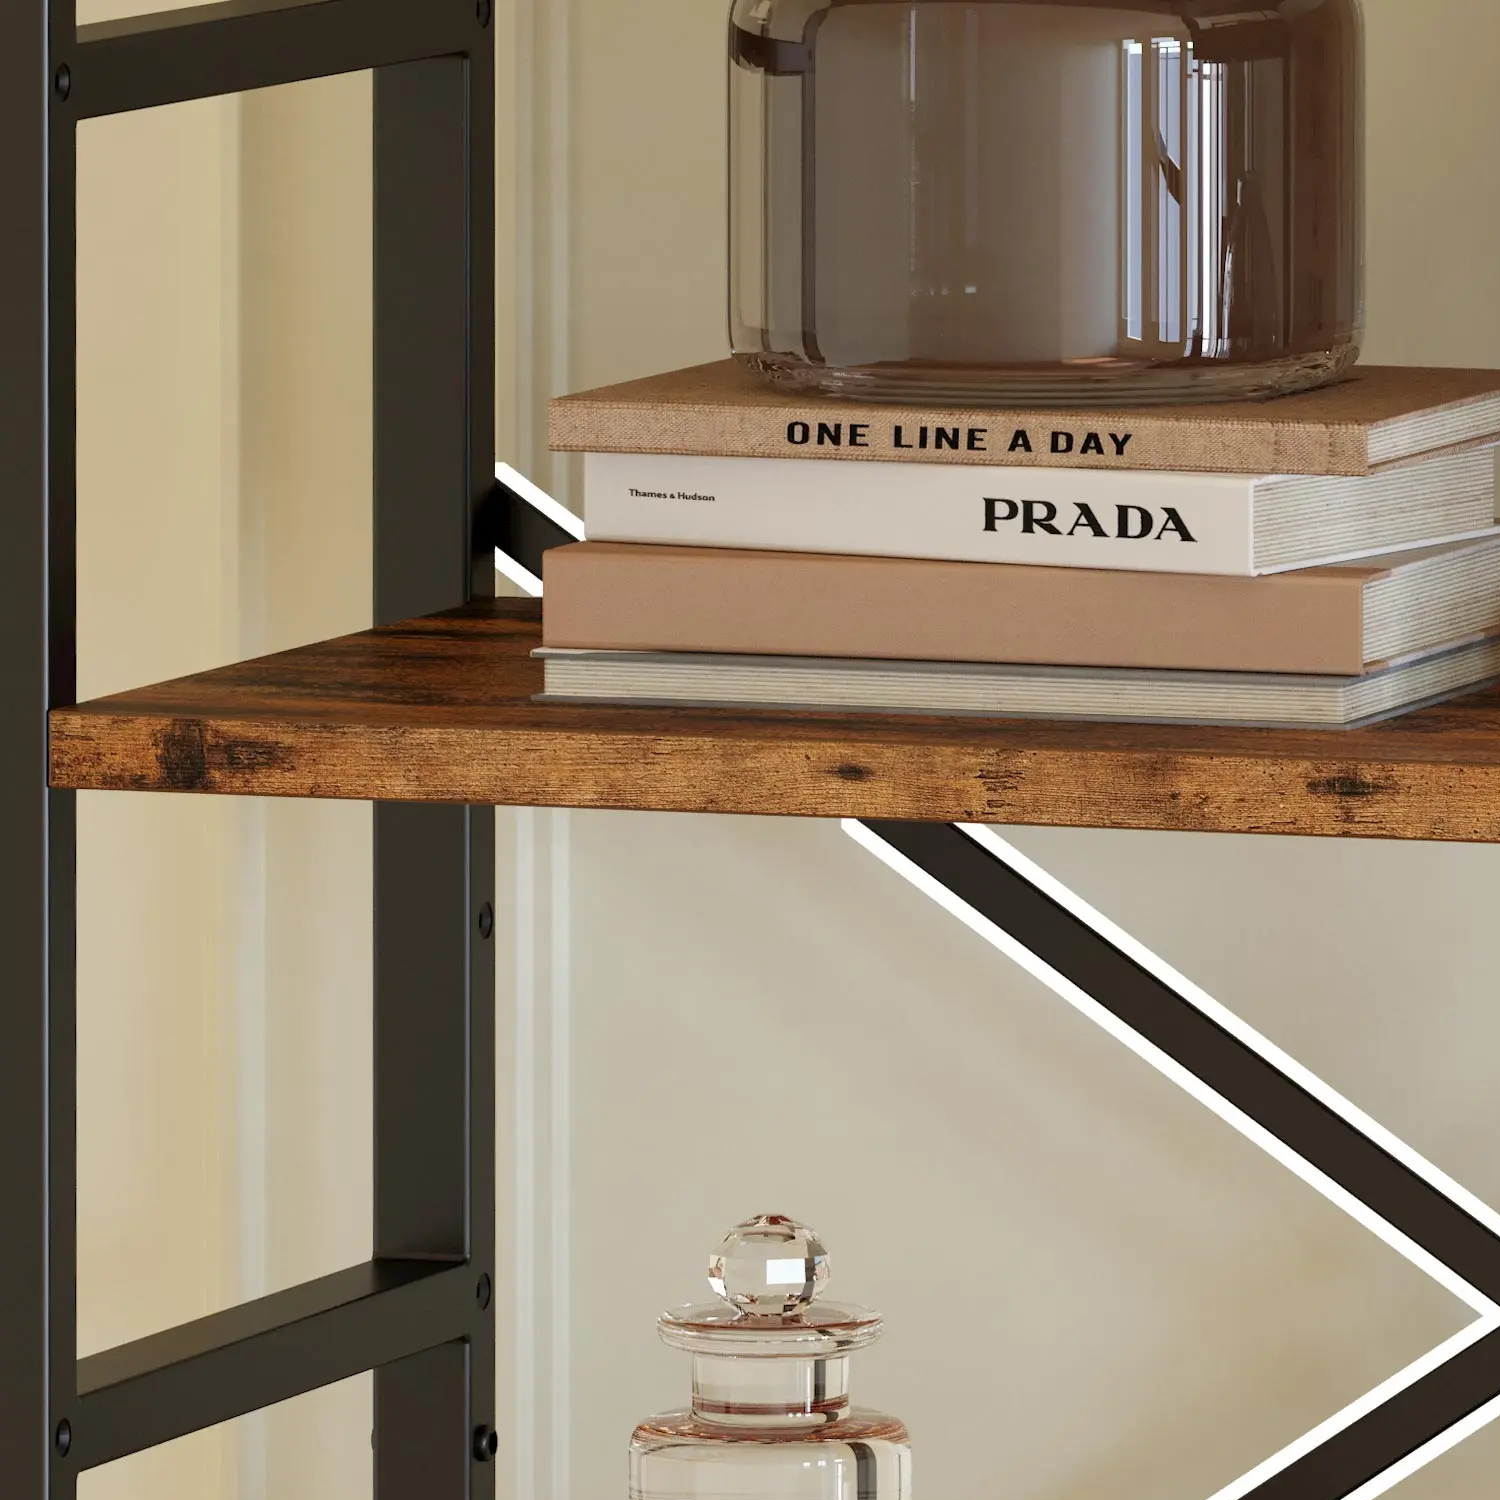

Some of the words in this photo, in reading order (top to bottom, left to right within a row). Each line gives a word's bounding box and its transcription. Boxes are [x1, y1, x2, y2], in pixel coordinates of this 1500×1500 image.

[787, 421, 871, 447] ONE
[893, 425, 988, 451] LINE
[1008, 429, 1033, 453] A
[1050, 431, 1133, 456] DAY
[628, 488, 668, 499] Thames
[677, 492, 716, 502] Hudson
[982, 497, 1198, 542] PRADA
